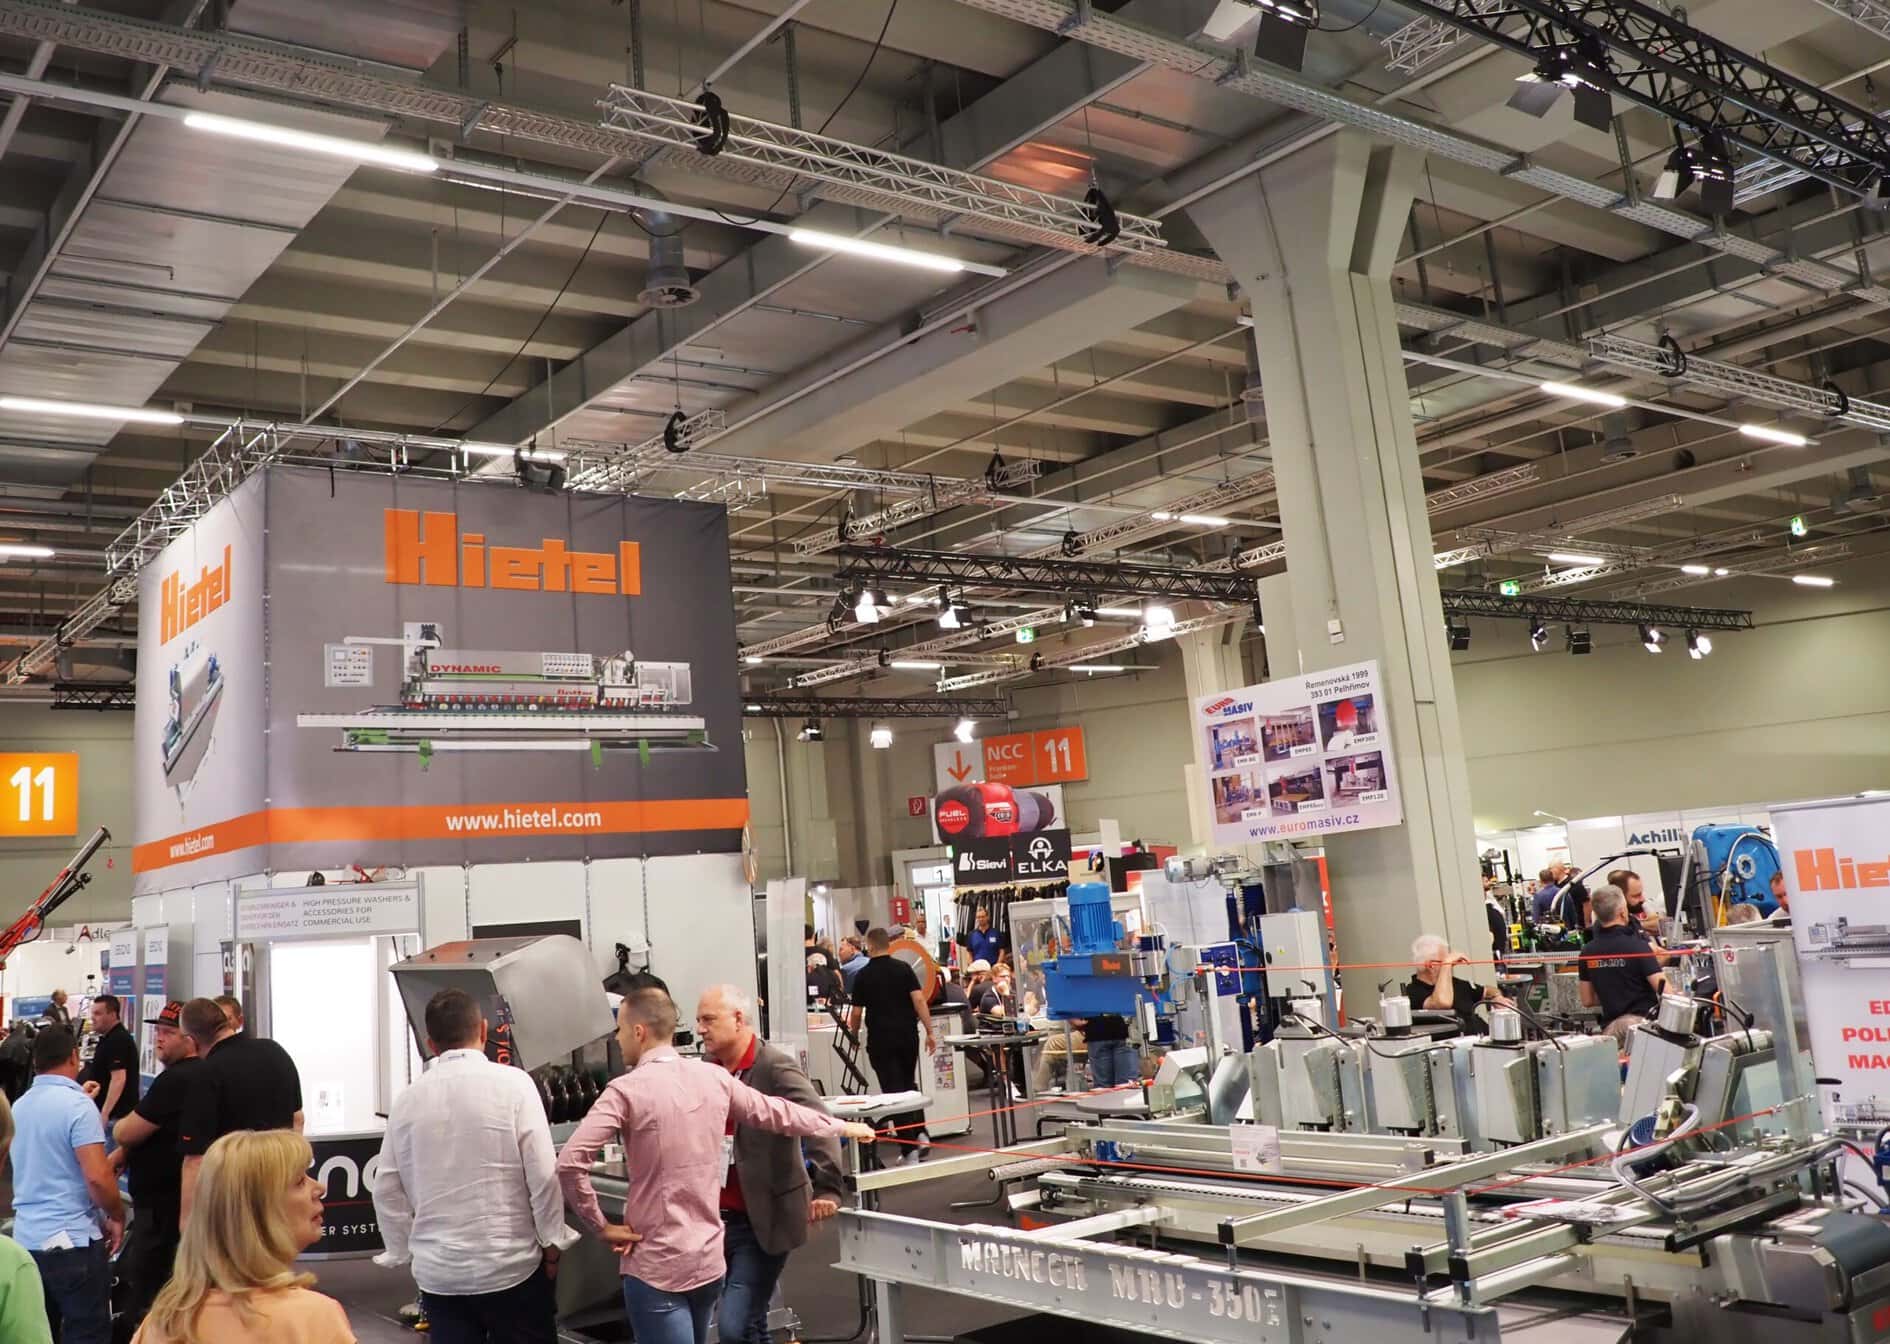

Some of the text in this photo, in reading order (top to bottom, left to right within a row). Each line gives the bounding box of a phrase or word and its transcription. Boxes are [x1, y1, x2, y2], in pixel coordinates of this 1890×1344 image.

[384, 508, 641, 596] Hietel
[160, 544, 231, 646] Hietel
[431, 665, 502, 673] DYNAMIC
[1223, 702, 1253, 716] MASIV
[987, 743, 1024, 761] NCC
[1044, 737, 1072, 773] 11
[10, 766, 54, 821] 11
[445, 808, 602, 831] www.hietel.com
[1249, 815, 1359, 837] www.euromasiv.cz
[976, 858, 1007, 869] Sievi
[1018, 860, 1067, 874] ELKA
[1793, 848, 1890, 891] Hie
[322, 896, 361, 905] PRESSURE
[363, 895, 403, 904] WASHERS
[405, 894, 411, 902] &
[303, 906, 372, 916] ACCESSORIES FOR
[303, 916, 371, 927] COMMERCIAL USE
[77, 925, 112, 943] Adle
[1842, 1027, 1890, 1042] POL
[320, 1222, 380, 1236] ER SYST
